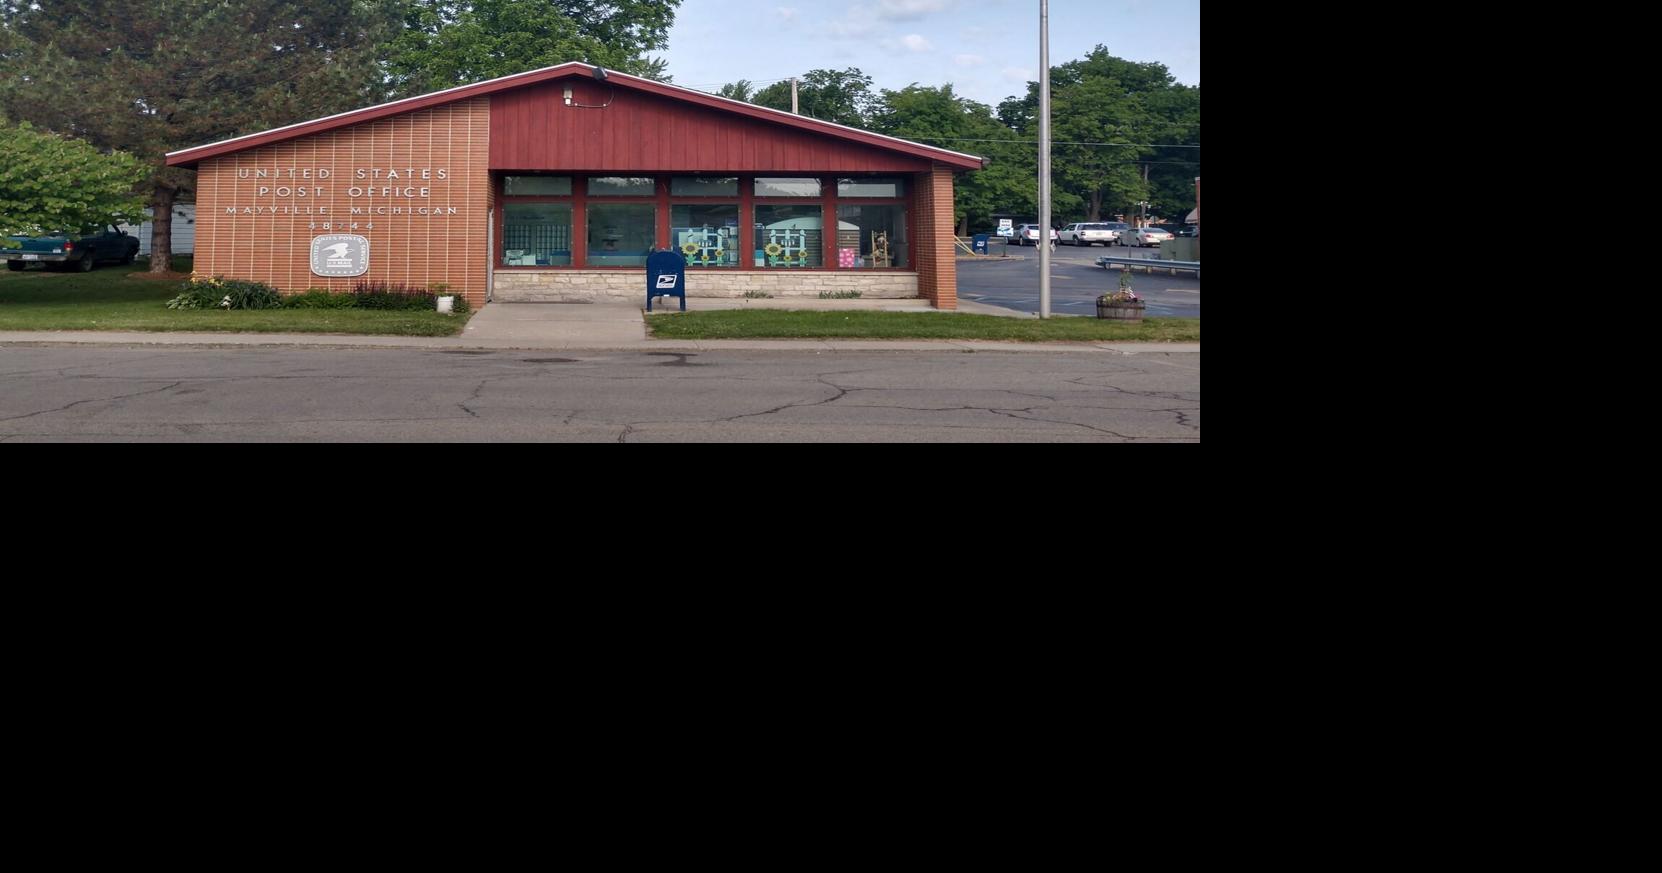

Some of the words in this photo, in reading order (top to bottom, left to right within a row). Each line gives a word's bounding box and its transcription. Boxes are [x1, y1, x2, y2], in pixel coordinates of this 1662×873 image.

[238, 168, 331, 180] UNITED
[356, 168, 448, 180] STATES
[259, 186, 324, 198] POST
[348, 186, 430, 198] OFFICE
[226, 206, 328, 215] MAYVILLE
[350, 206, 457, 215] MICHIGAN
[308, 222, 374, 230] 48744
